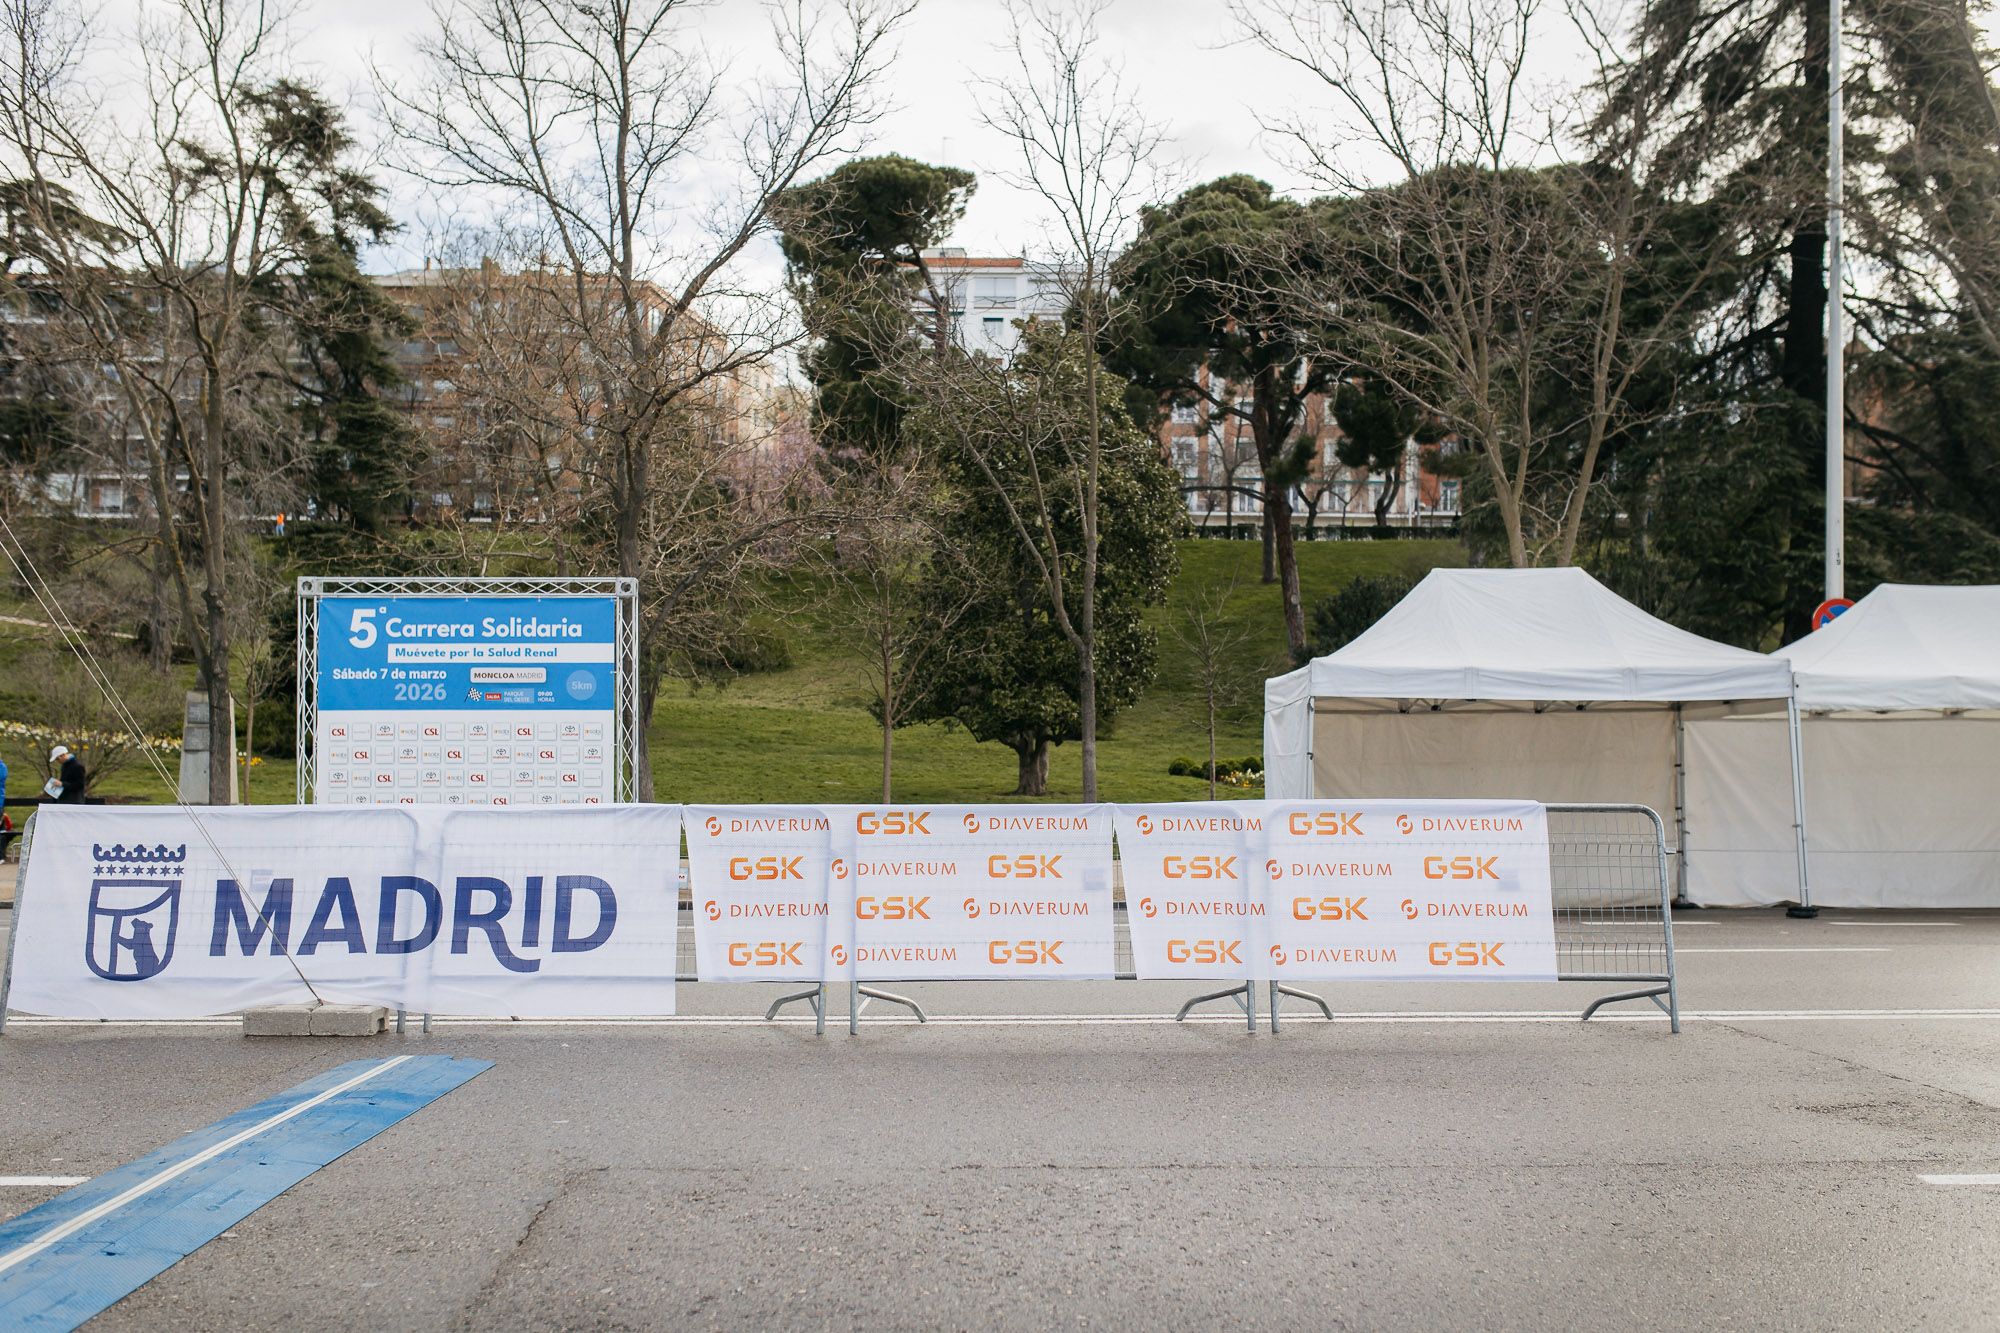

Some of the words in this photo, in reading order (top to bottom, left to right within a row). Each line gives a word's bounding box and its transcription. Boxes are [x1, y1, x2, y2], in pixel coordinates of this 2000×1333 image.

[385, 617, 475, 638] Carrera
[481, 616, 583, 638] Solidaria
[395, 647, 447, 658] Muévete
[449, 649, 470, 659] por
[473, 647, 484, 657] la
[488, 647, 521, 658] Salud
[524, 647, 557, 657] Renal
[332, 667, 377, 680] Sábado
[380, 668, 388, 679] 7
[391, 668, 406, 680] de
[409, 670, 447, 680] marzo
[394, 683, 447, 701] 2026
[571, 680, 593, 690] 5km
[331, 728, 346, 736] CSL
[424, 728, 439, 736] CSL
[517, 728, 532, 736] CSL
[354, 751, 369, 759] CSL
[447, 751, 462, 759] CSL
[539, 751, 554, 759] CSL
[377, 774, 392, 782] CSL
[470, 774, 485, 782] CSL
[562, 774, 577, 782] CSL
[730, 816, 830, 834] DIAVERUM
[857, 811, 929, 836] GSK
[988, 816, 1088, 833] DIAVERUM
[1161, 817, 1262, 833] DIAVERUM
[1289, 812, 1364, 836] GSK
[1421, 816, 1522, 833] DIAVERUM
[728, 856, 804, 881] GSK
[857, 861, 957, 877] DIAVERUM
[988, 854, 1062, 879] GSK
[1163, 855, 1237, 880] GSK
[1291, 862, 1392, 878] DIAVERUM
[1424, 855, 1500, 880] GSK
[730, 902, 828, 920] DIAVERUM
[855, 896, 931, 920] GSK
[988, 901, 1088, 917] DIAVERUM
[1164, 899, 1264, 917] DIAVERUM
[1292, 896, 1368, 921] GSK
[1425, 902, 1527, 918] DIAVERUM
[209, 875, 618, 973] MADRID
[728, 941, 803, 967] GSK
[856, 947, 957, 963] DIAVERUM
[988, 940, 1063, 965] GSK
[1167, 939, 1242, 965] GSK
[1295, 947, 1396, 964] DIAVERUM
[1428, 941, 1504, 967] GSK
